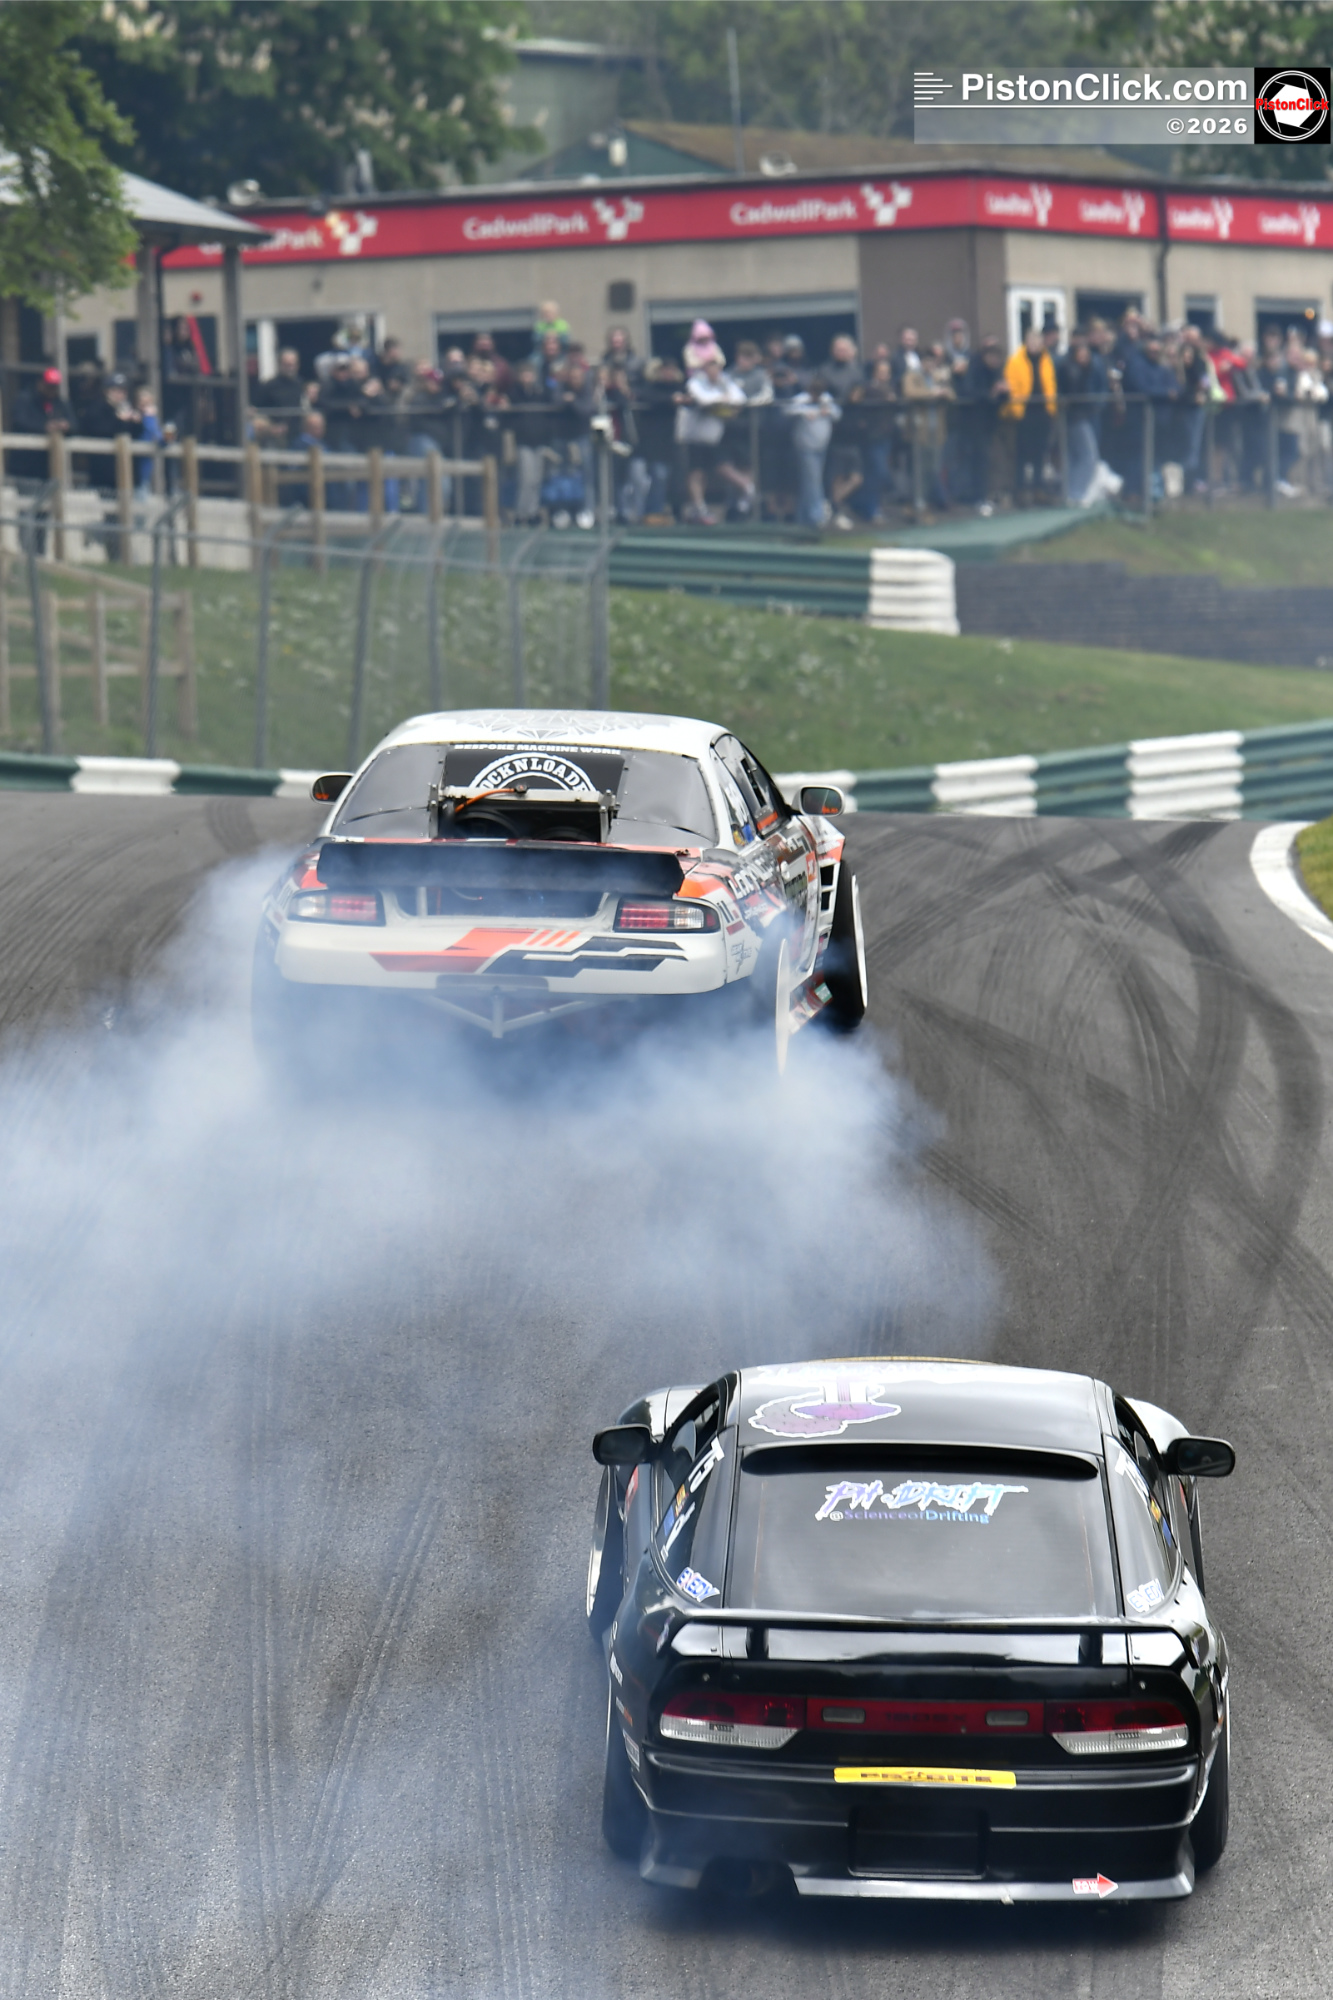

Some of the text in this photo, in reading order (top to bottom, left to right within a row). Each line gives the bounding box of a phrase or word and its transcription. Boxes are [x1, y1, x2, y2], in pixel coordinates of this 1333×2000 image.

[454, 743, 515, 751] BESPOKE
[516, 744, 579, 753] MACHINE
[829, 1509, 991, 1524] @ScienceofDrifting
